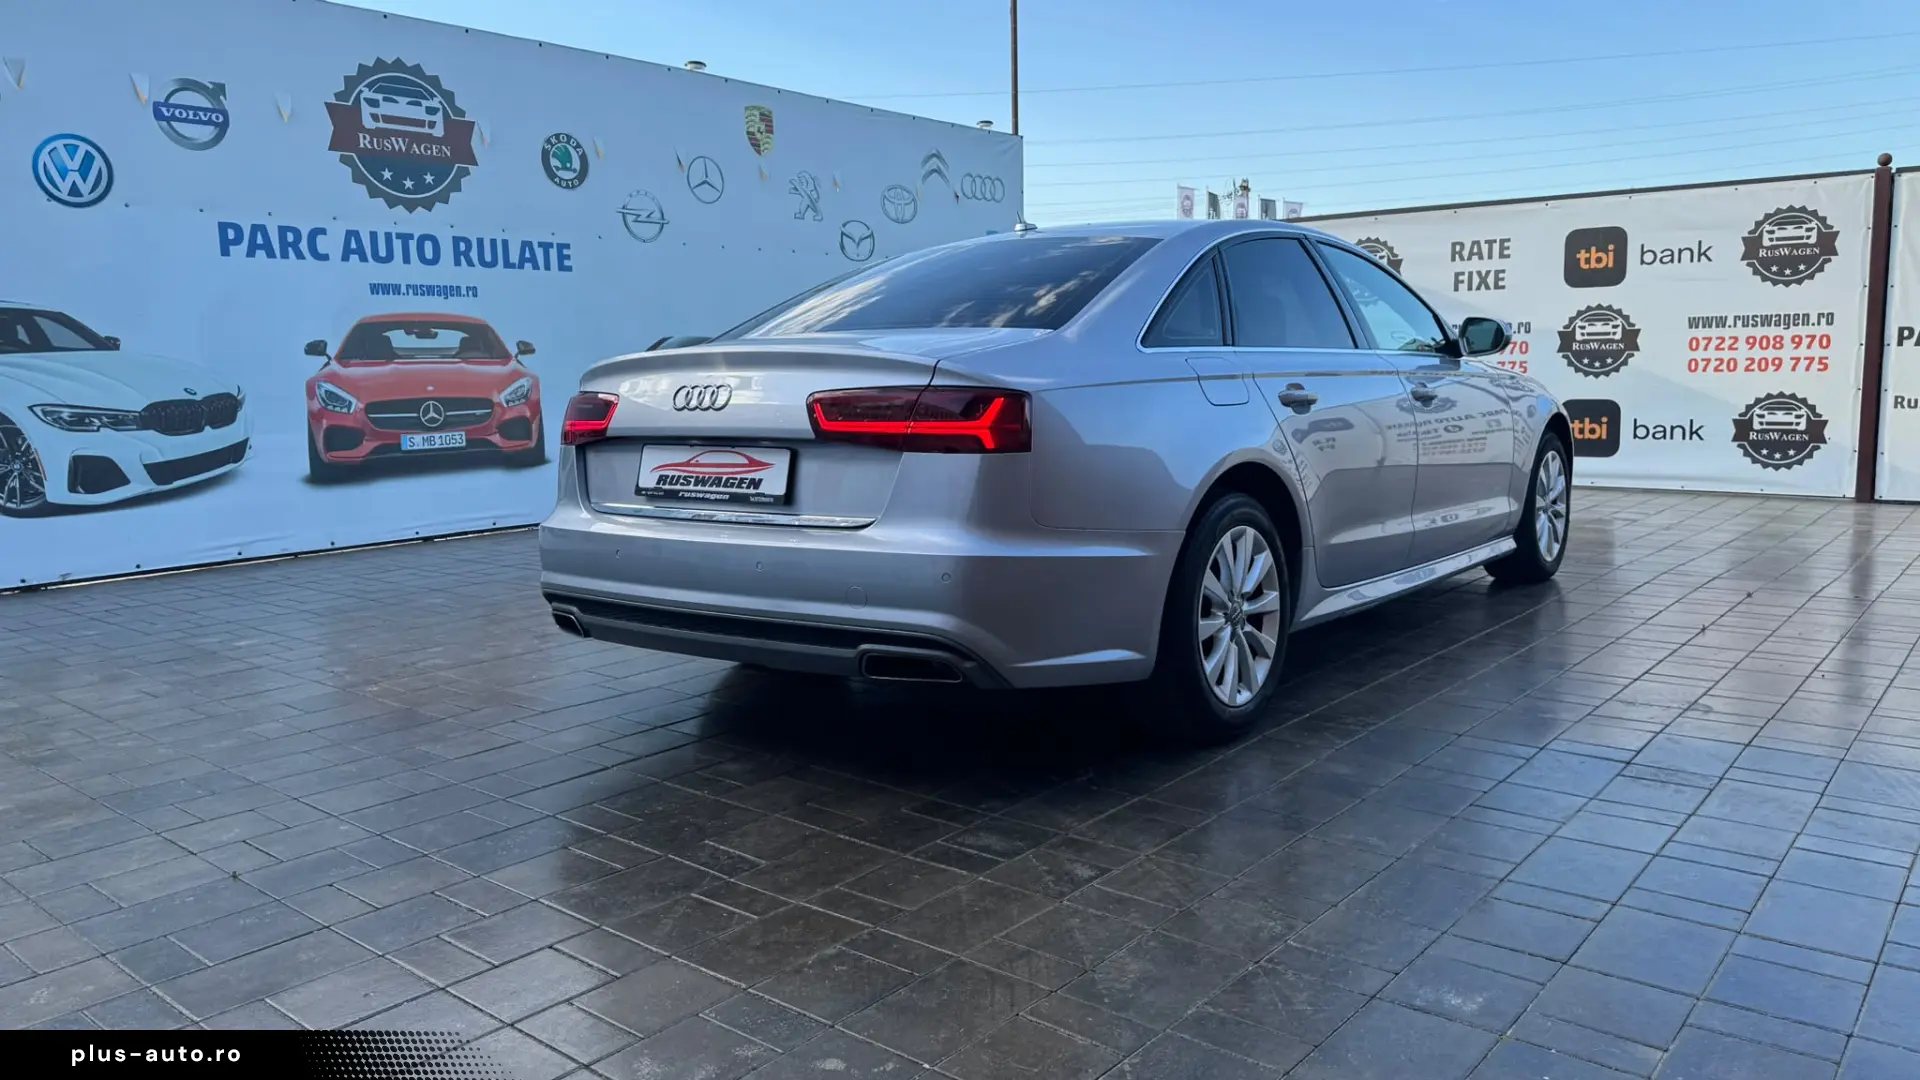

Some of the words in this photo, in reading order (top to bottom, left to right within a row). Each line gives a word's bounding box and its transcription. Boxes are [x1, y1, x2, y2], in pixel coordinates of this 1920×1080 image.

[158, 106, 224, 123] VOLVO
[554, 177, 580, 188] AUTO
[217, 221, 330, 262] PARC
[340, 229, 442, 267] AUTO
[451, 235, 574, 273] RULATE
[1450, 238, 1511, 262] RATE
[1576, 244, 1616, 270] tbi
[1640, 239, 1714, 267] bank
[1453, 269, 1506, 292] FIXE
[369, 282, 479, 300] www.ruswagen.ro
[1687, 311, 1836, 330] www.ruswagen.ro
[1688, 335, 1740, 352] 0722
[1744, 334, 1785, 352] 908
[1790, 333, 1832, 351] 970
[1687, 357, 1739, 374] 0720
[1743, 356, 1784, 373] 209
[1789, 356, 1830, 373] 775
[1893, 394, 1920, 410] Ru
[1571, 416, 1608, 440] tbi
[1633, 418, 1705, 441] bank
[655, 474, 764, 490] RUSWAGEN
[678, 490, 730, 501] ruswagen
